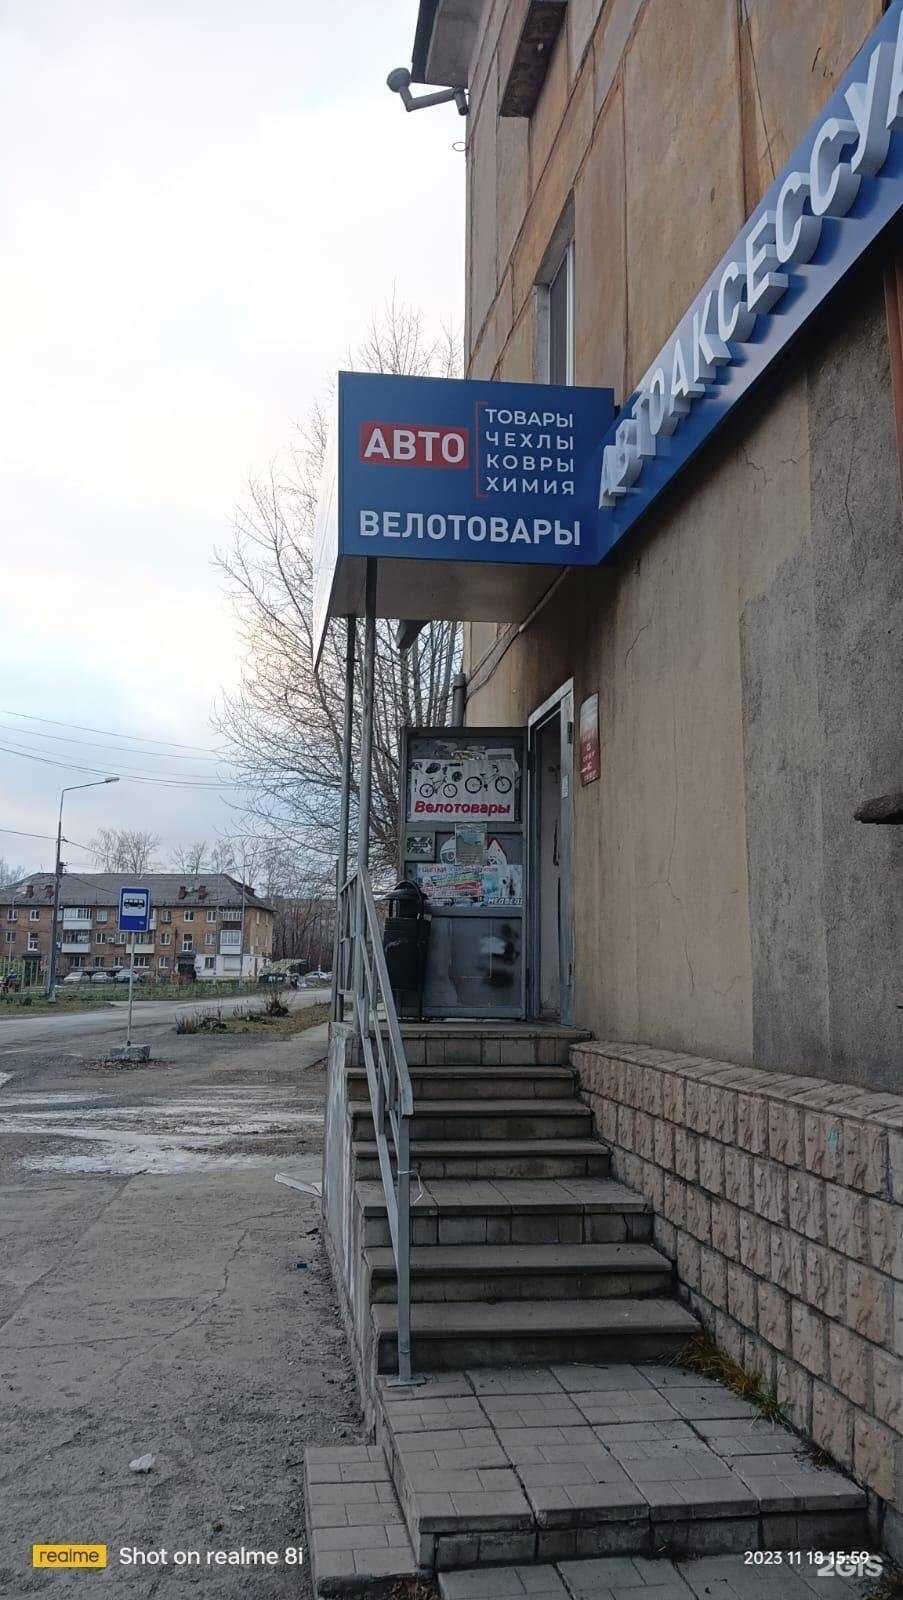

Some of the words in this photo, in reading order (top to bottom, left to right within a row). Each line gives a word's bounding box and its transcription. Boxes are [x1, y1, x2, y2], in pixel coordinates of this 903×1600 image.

[484, 408, 574, 428] ТОВАРЫ
[363, 427, 465, 464] АВТО
[485, 431, 574, 451] ЧЕХЛЫ
[485, 453, 575, 473] КОВРЫ
[485, 476, 575, 496] ХИМИЯ
[359, 510, 581, 546] ВЕЛОТОВАРЫ
[414, 800, 511, 816] Велотовары
